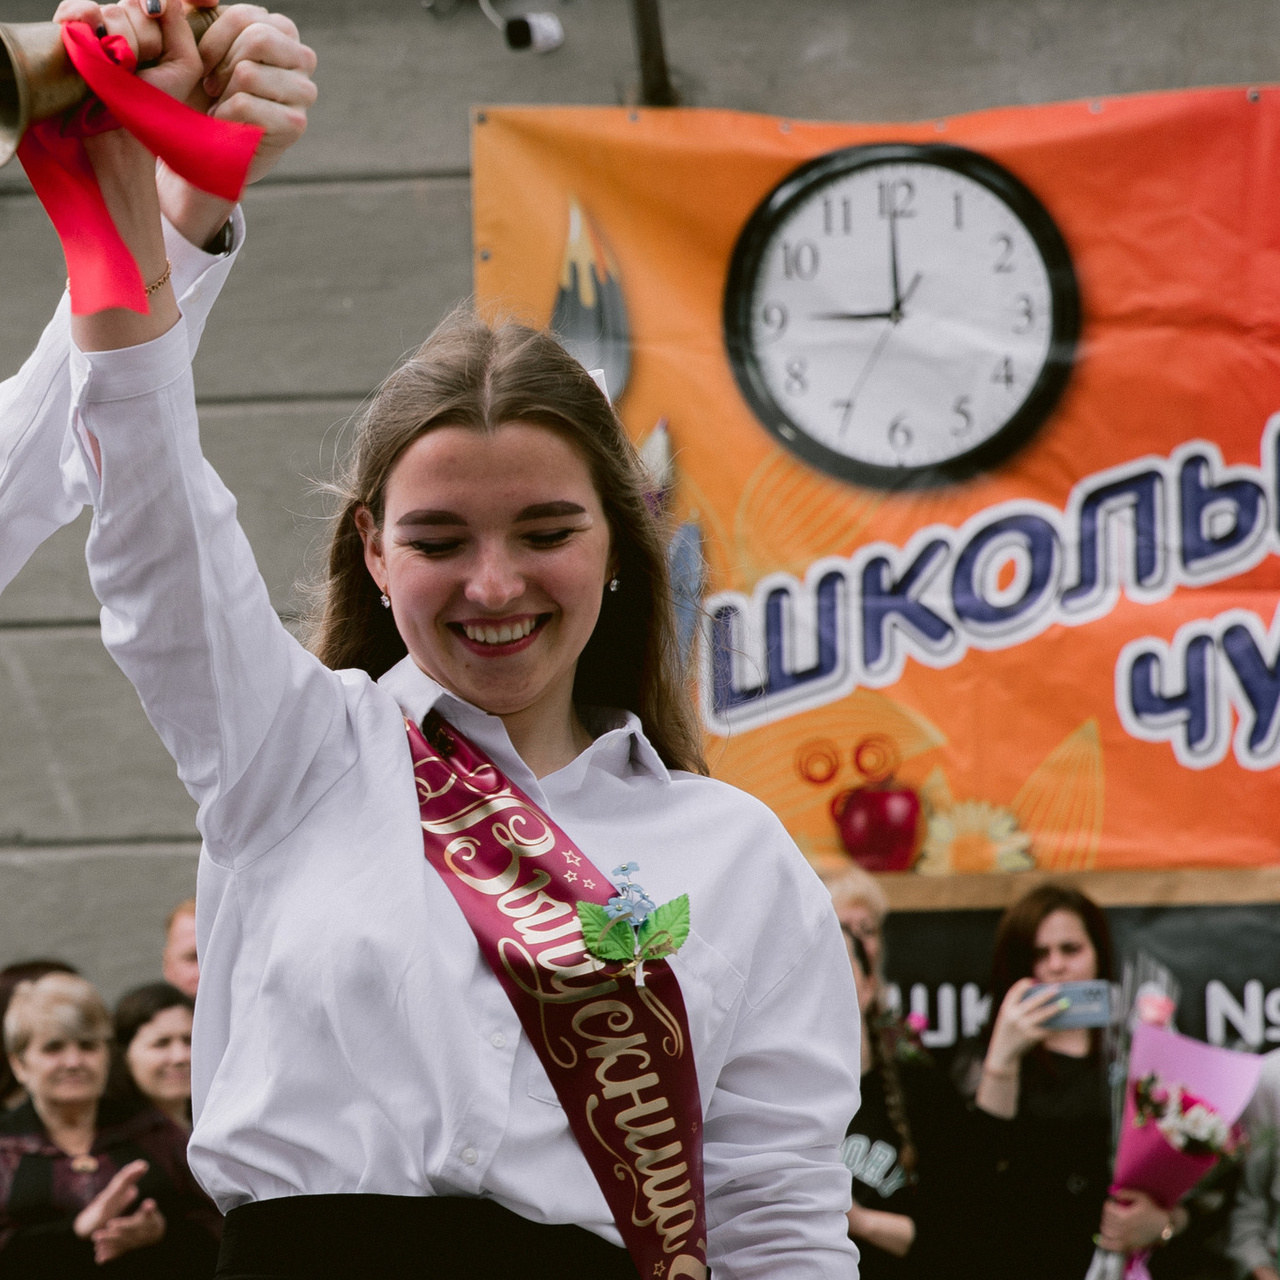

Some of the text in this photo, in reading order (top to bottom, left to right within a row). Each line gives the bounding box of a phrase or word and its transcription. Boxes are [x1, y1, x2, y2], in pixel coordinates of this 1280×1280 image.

[823, 196, 852, 235] 11
[877, 179, 918, 218] 12
[953, 190, 964, 231] 1
[782, 238, 818, 282] 10
[991, 231, 1015, 273] 2
[762, 300, 789, 343] 9
[1012, 294, 1035, 335] 3
[785, 357, 809, 397] 8
[991, 355, 1014, 390] 4
[832, 398, 854, 437] 7
[887, 414, 914, 451] 6
[951, 394, 973, 437] 5
[708, 428, 1280, 718] ШКОЛЬ
